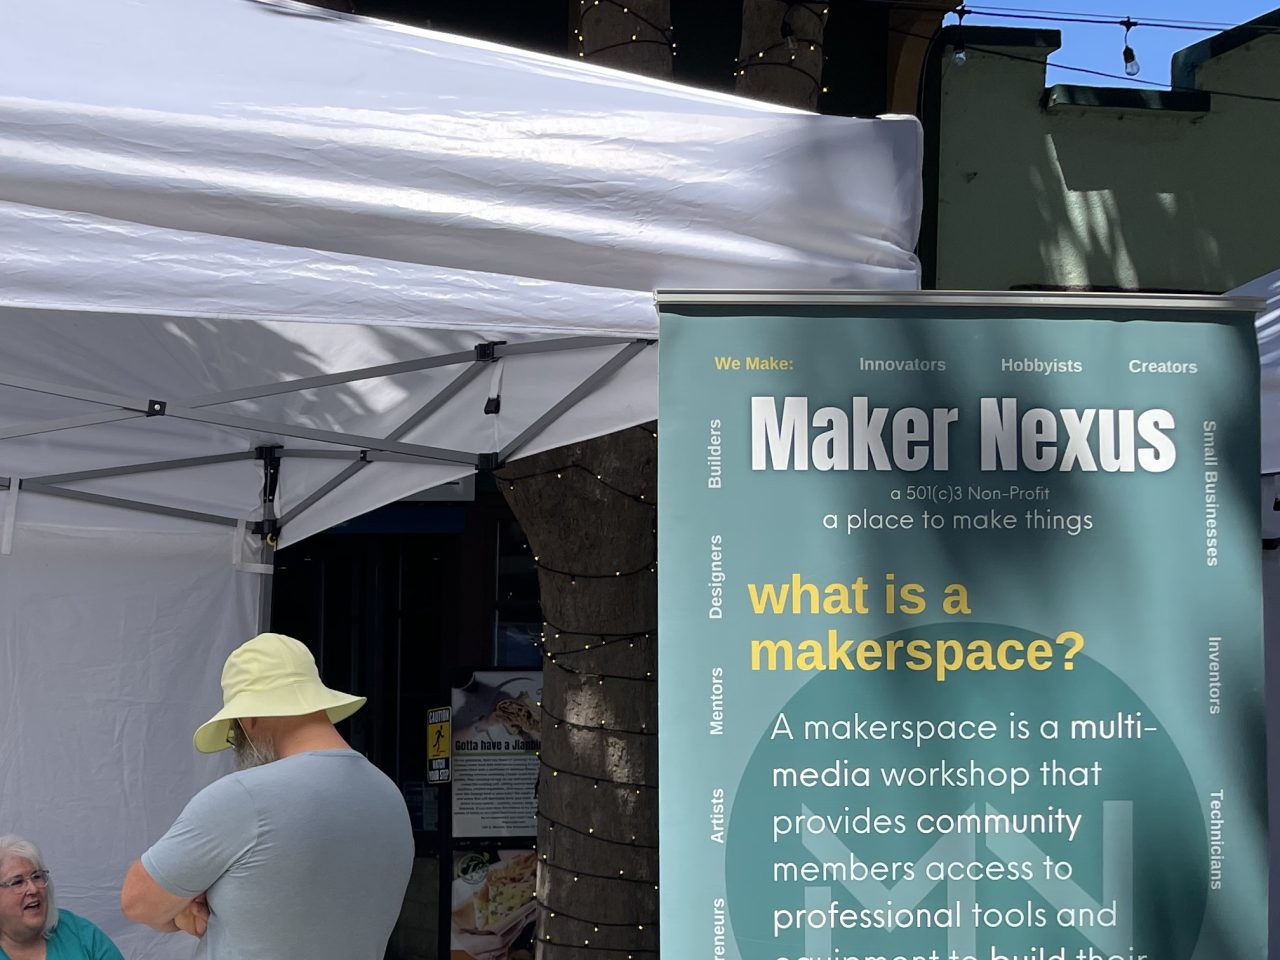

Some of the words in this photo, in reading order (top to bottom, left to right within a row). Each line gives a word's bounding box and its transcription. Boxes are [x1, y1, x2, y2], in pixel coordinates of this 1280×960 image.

[715, 357, 740, 369] We
[746, 357, 793, 370] Make:
[860, 358, 945, 370] Innovators
[1002, 358, 1082, 375] Hobbyists
[1129, 360, 1197, 373] Creators
[751, 396, 958, 472] Maker
[981, 398, 1176, 472] Nexus
[1204, 421, 1218, 466] Small
[708, 420, 721, 488] Builders
[890, 488, 900, 500] a
[907, 485, 962, 503] 501(c)3
[969, 486, 1049, 500] Non-Profit
[823, 515, 837, 528] a
[848, 509, 913, 534] place
[922, 511, 944, 528] to
[954, 509, 1017, 529] make
[1025, 509, 1092, 535] things
[1205, 472, 1219, 566] Businesses
[708, 535, 725, 618] Designers
[748, 574, 868, 614] what
[885, 574, 926, 614] is
[943, 584, 971, 614] a
[752, 630, 1084, 681] makerspace?
[1209, 637, 1221, 714] Inventors
[710, 668, 723, 734] Mentors
[456, 740, 478, 750] Gotta
[481, 741, 502, 750] have
[505, 742, 509, 750] a
[771, 712, 793, 739] A
[805, 713, 997, 747] makerspace
[1009, 714, 1030, 739] is
[1041, 721, 1058, 739] a
[1072, 712, 1156, 739] multi-
[774, 760, 869, 787] media
[881, 760, 1029, 794] workshop
[1040, 760, 1102, 786] that
[710, 789, 724, 843] Artists
[774, 807, 905, 842] provides
[917, 806, 1082, 841] community
[1211, 789, 1224, 889] Technicians
[774, 853, 914, 882] members
[926, 862, 1033, 881] access
[1043, 856, 1072, 879] to
[775, 901, 960, 937] professional
[972, 901, 1046, 928] tools
[1057, 900, 1116, 927] and
